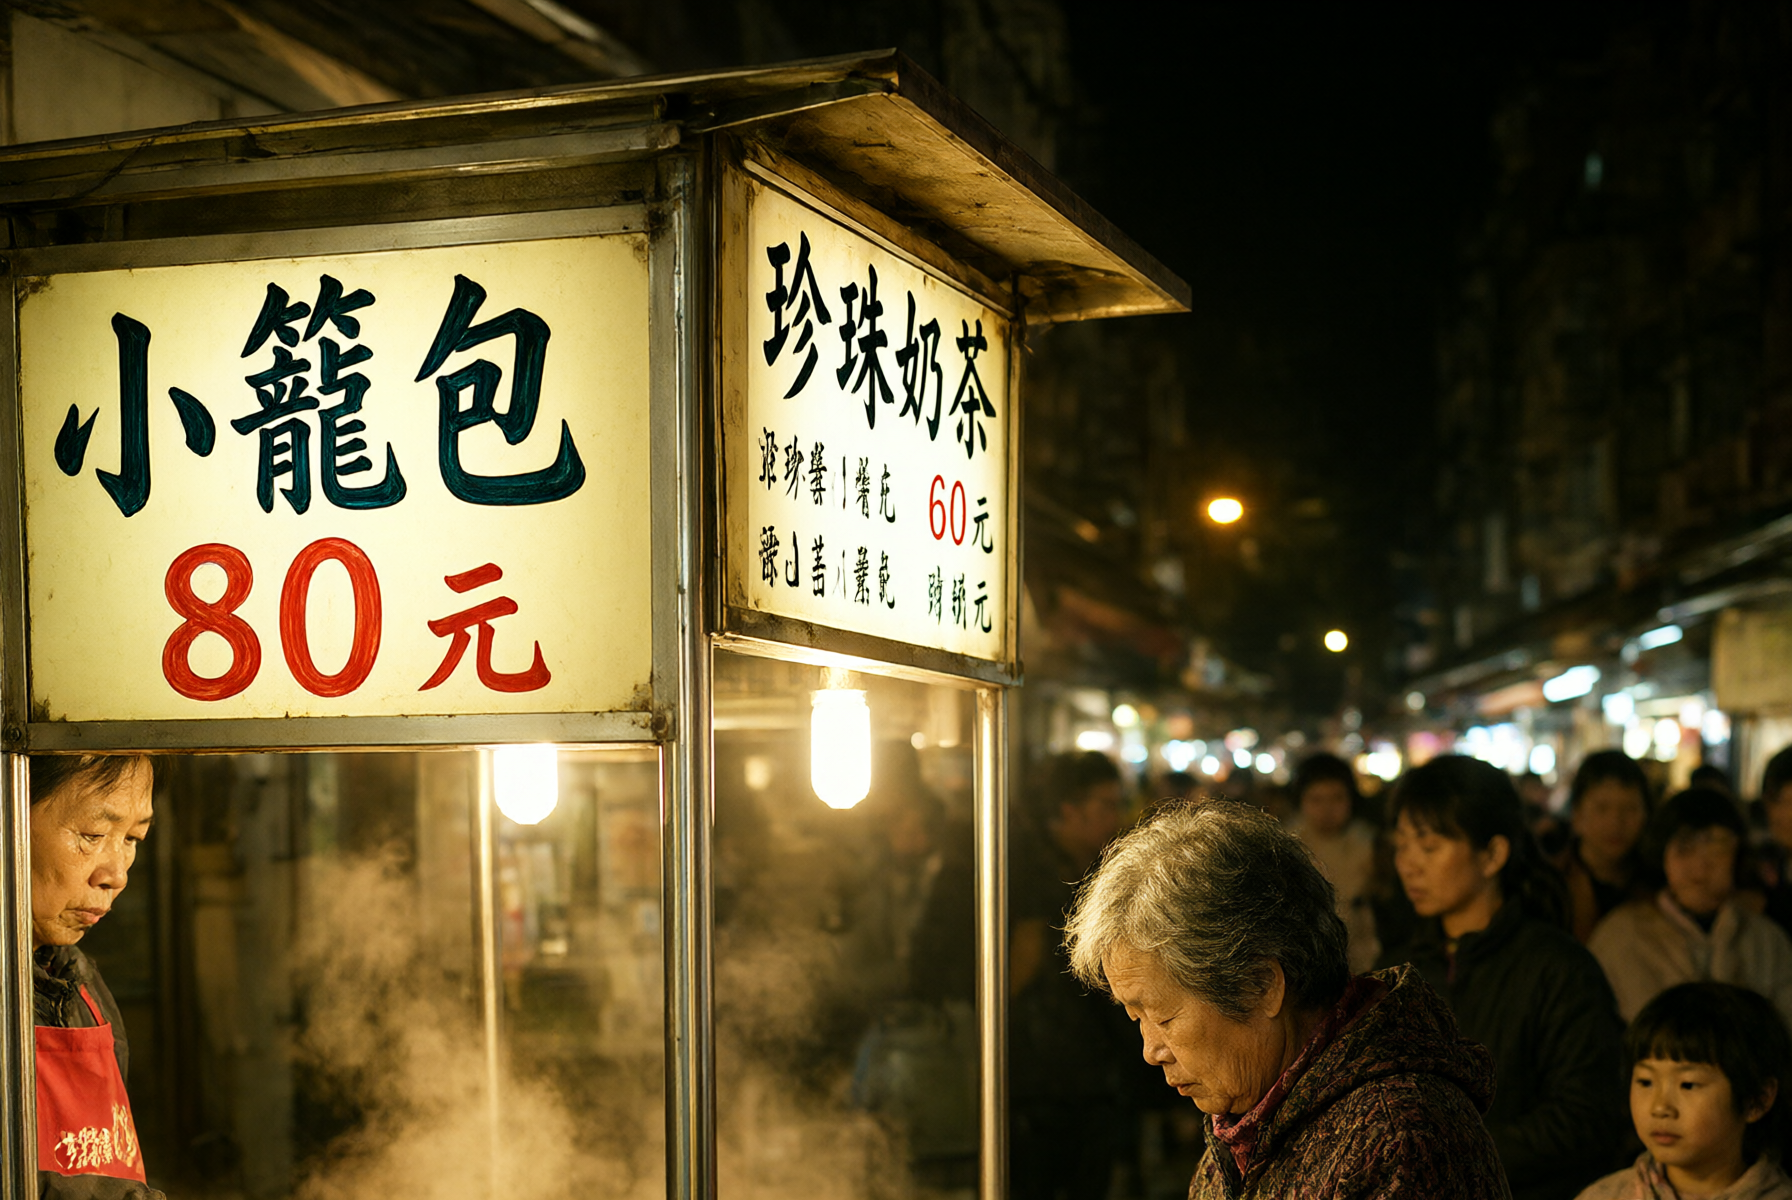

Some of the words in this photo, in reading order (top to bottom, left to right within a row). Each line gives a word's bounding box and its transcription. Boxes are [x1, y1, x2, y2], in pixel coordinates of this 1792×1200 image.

[54, 273, 587, 518] 小籠包
[763, 230, 997, 460] 珍珠奶茶
